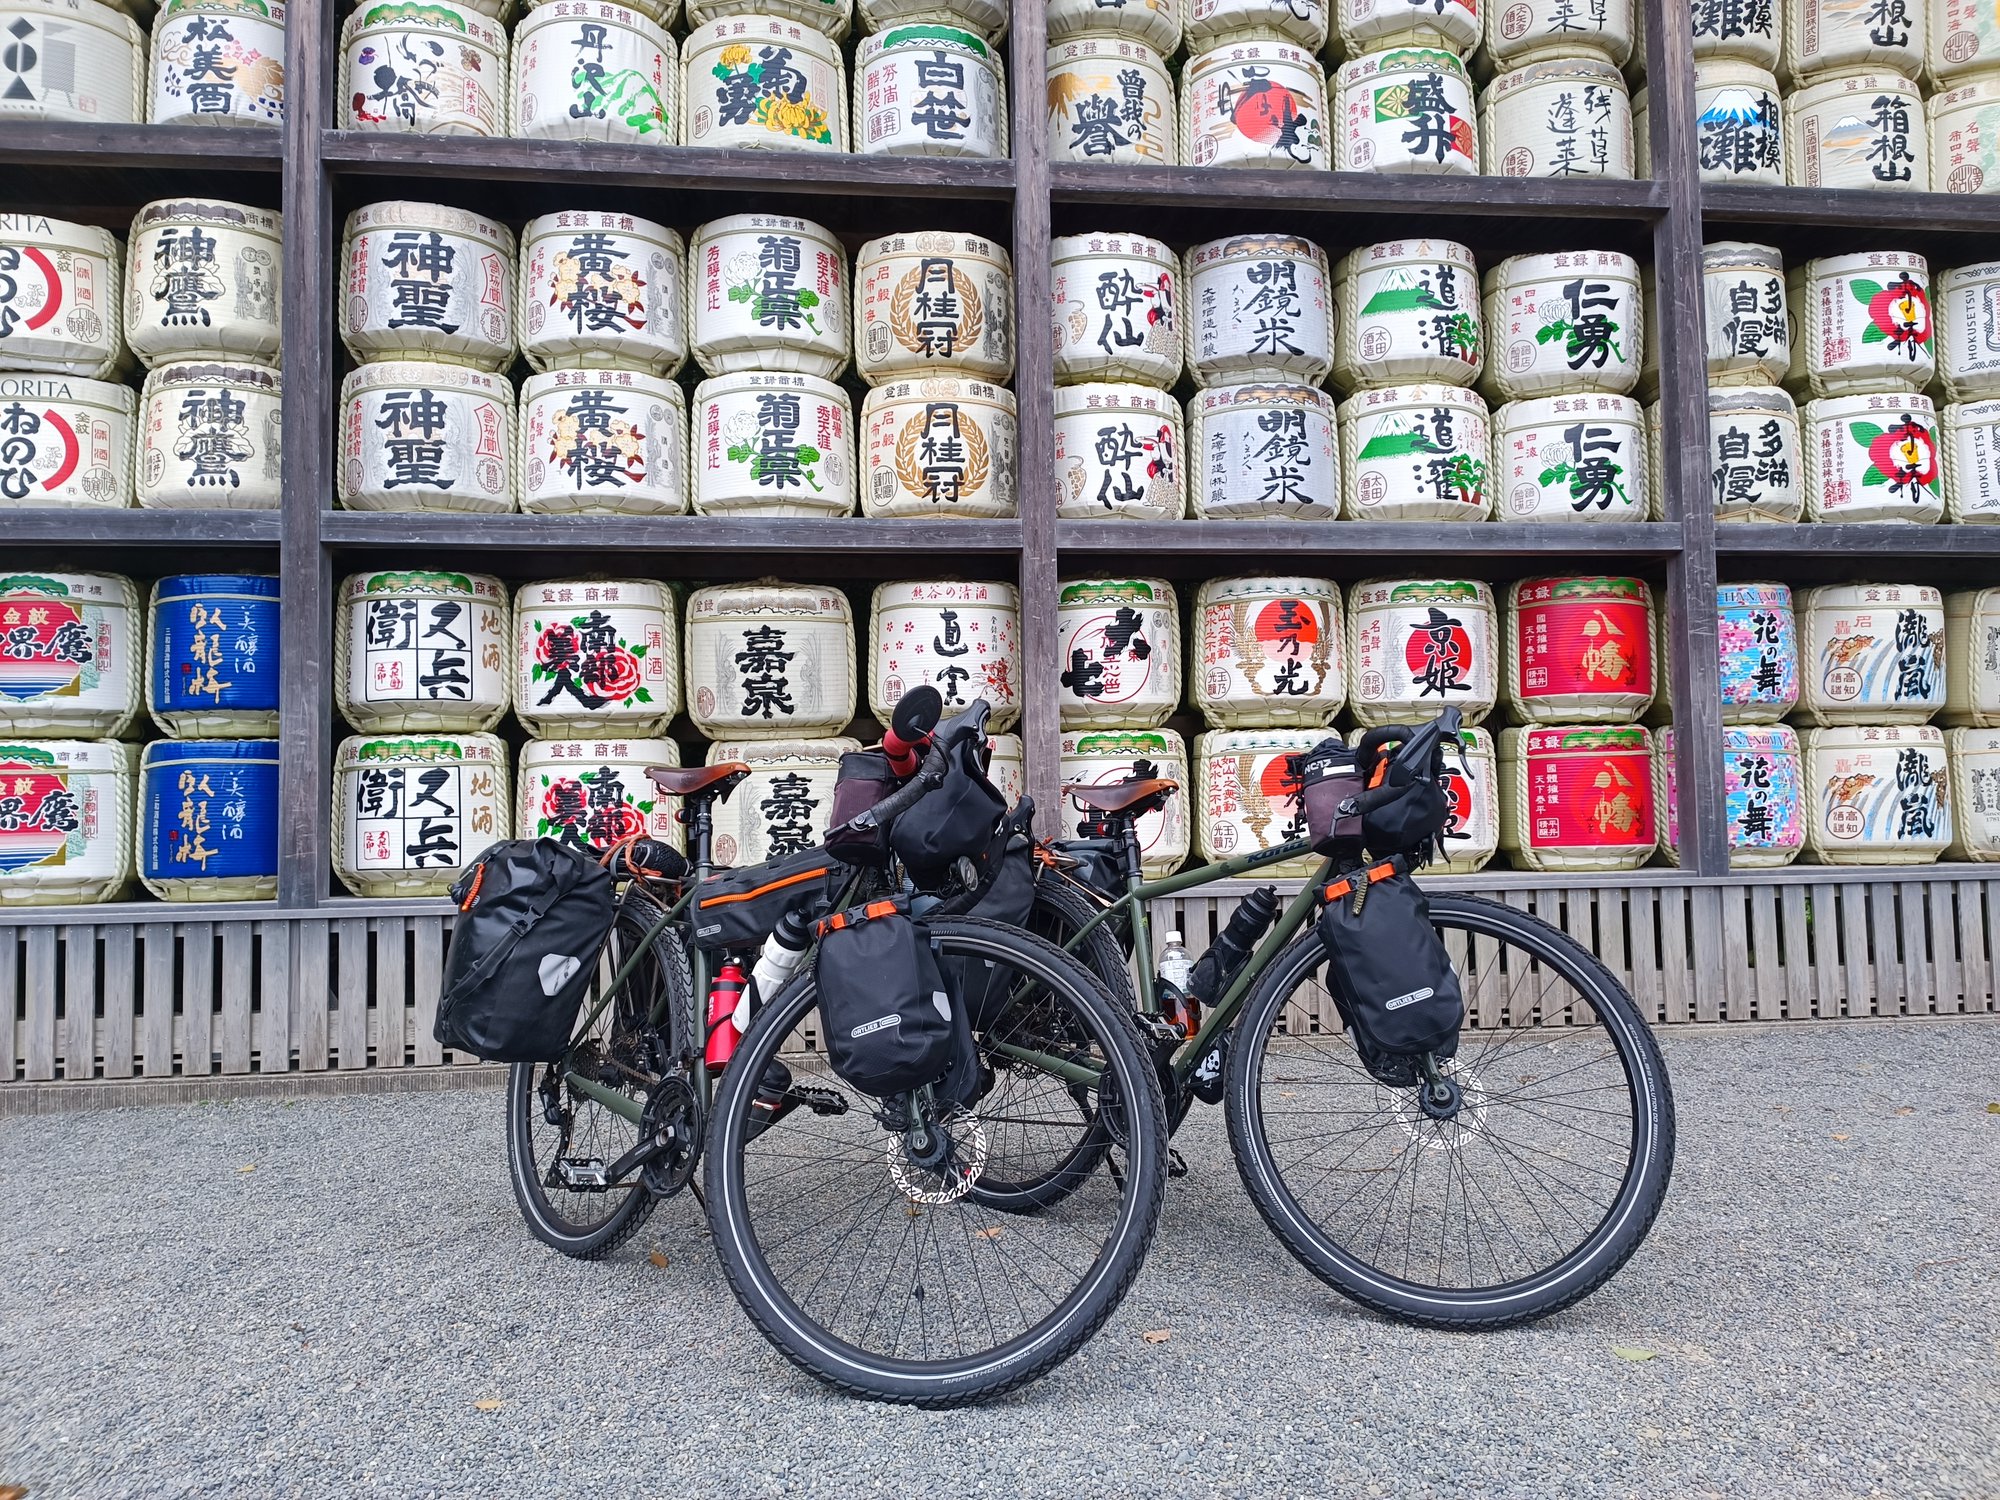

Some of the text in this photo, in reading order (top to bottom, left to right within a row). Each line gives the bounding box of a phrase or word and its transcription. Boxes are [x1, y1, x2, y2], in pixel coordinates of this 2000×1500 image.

[600, 5, 632, 25] 商標
[468, 22, 495, 46] 商標
[715, 21, 801, 41] 登録 商標
[1064, 42, 1149, 62] 登録 商標
[1231, 48, 1301, 62] 登録 商標
[1348, 61, 1378, 83] 登録
[1497, 73, 1523, 91] 登録
[1402, 72, 1457, 164] 盛升
[1755, 91, 1783, 175] 相模
[1866, 95, 1914, 182] 箱根山
[556, 213, 634, 232] 登録 商標
[880, 238, 990, 256] 登録 商標
[1089, 239, 1158, 257] 登録 商標
[1195, 246, 1222, 266] 登録
[1371, 244, 1404, 260] 登録
[1554, 253, 1623, 269] 登録 商標
[382, 231, 460, 335] 神聖
[757, 235, 801, 331] 菊正宗
[914, 258, 959, 358] 月桂冠
[1723, 279, 1769, 357] 自慢
[1563, 279, 1619, 371] 仁勇
[1965, 289, 1977, 360] HOKUSETSU
[555, 372, 633, 386] 登録 商標
[885, 383, 996, 400] 登録 商標
[1205, 392, 1233, 410] 登録
[1366, 390, 1398, 406] 登録
[1086, 395, 1157, 410] 登録 商標
[1553, 399, 1588, 413] 登録
[374, 388, 455, 490] 神聖
[756, 393, 801, 489] 菊正宗
[0, 402, 41, 499] ねのひ
[920, 402, 966, 504] 月桂冠
[1564, 423, 1622, 512] 仁勇
[1711, 425, 1763, 504] 自慢
[1974, 426, 1990, 498] HOKUSETSU
[474, 582, 499, 597] 商標
[542, 587, 619, 602] 登録 商標
[911, 586, 989, 600] 熊谷の清酒
[1360, 590, 1389, 604] 登録
[1520, 587, 1549, 601] 登録
[1865, 589, 1900, 602] 登録
[0, 622, 93, 664] 界鷹
[648, 631, 662, 674] 清酒
[1274, 601, 1310, 695] 玉乃光
[1409, 608, 1472, 698] 京姫
[1580, 609, 1630, 681] 八幡
[1751, 614, 1782, 695] 花の舞
[735, 625, 795, 719] 嘉泉
[1528, 735, 1560, 750] 登録
[1864, 729, 1900, 741] 登録
[464, 747, 491, 759] 商標
[551, 743, 628, 757] 登録 商標
[1592, 761, 1639, 833] 八幡
[1738, 757, 1774, 839] 花の舞
[1387, 995, 1413, 1009] ORTLIEB
[853, 1022, 878, 1036] ORTLIEB
[942, 1351, 1031, 1384] MARATHON MONDIAL
